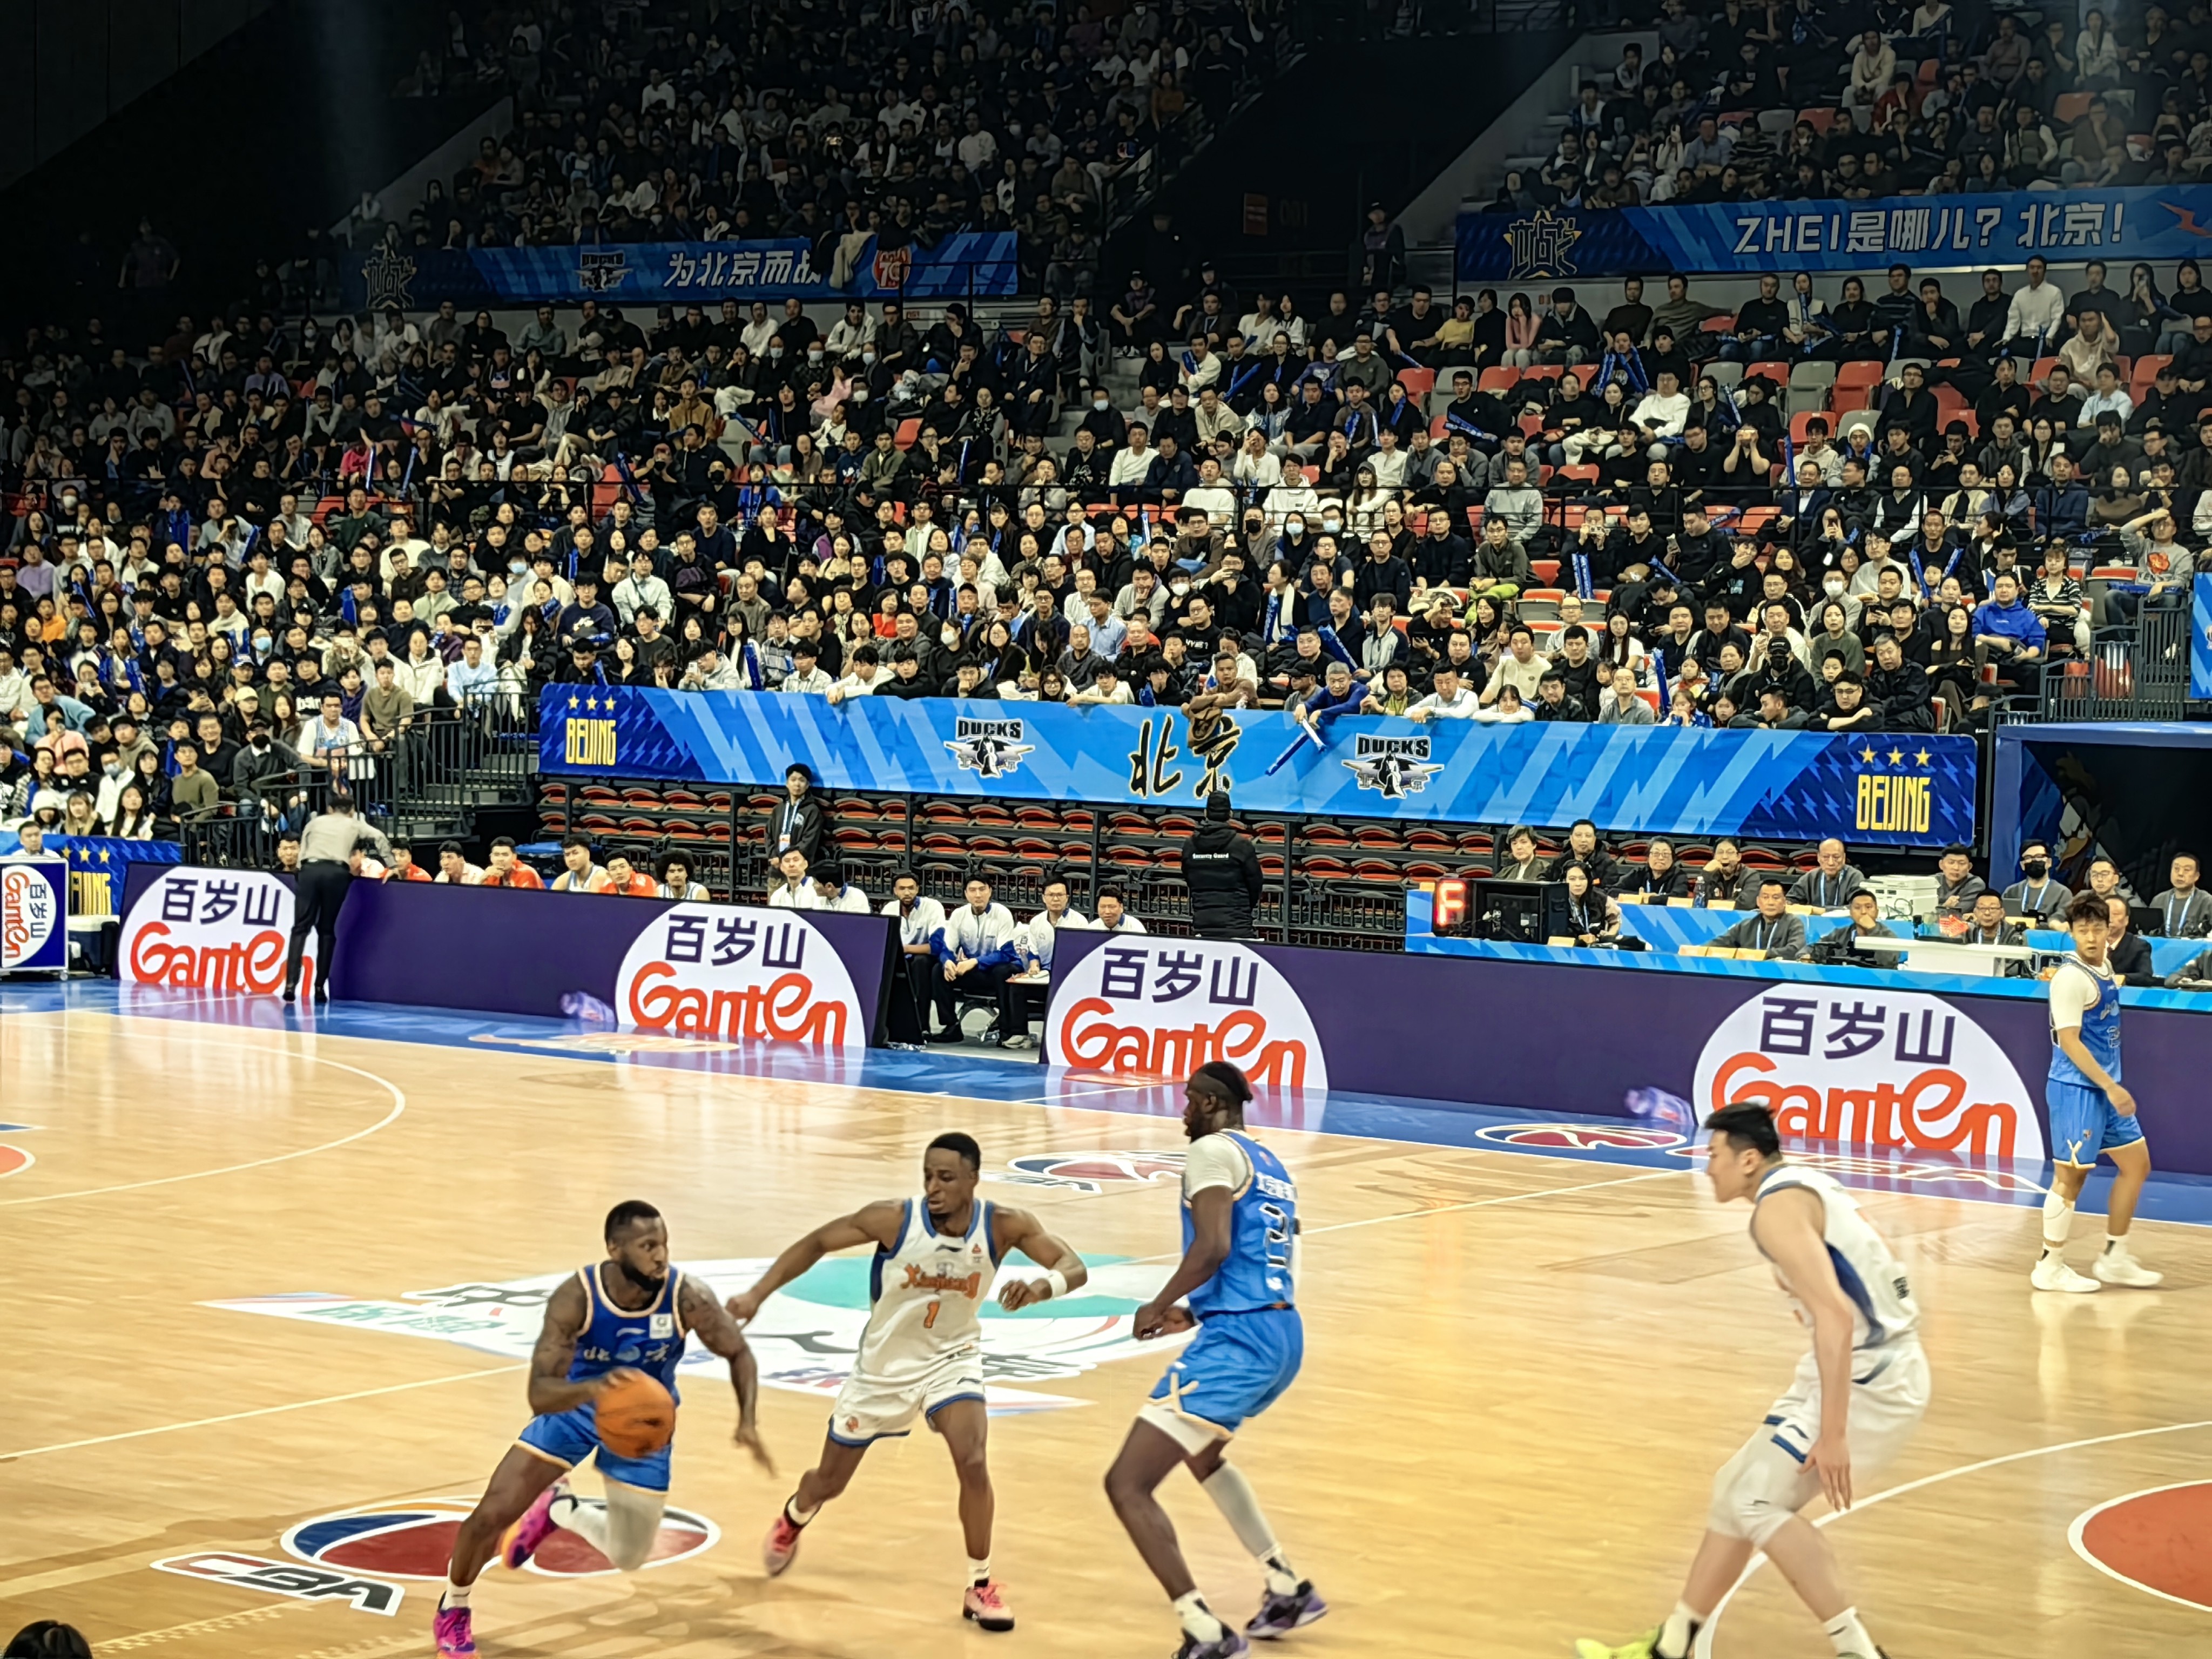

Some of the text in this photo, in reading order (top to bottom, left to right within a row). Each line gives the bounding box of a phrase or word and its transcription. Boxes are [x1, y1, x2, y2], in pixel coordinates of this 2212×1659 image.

[565, 718, 616, 766] BEIJING
[958, 720, 1022, 739] DUCKS
[1128, 713, 1242, 800] 北京
[1358, 736, 1429, 758] DUCKS
[1856, 774, 1931, 833] BEIJING
[161, 877, 281, 927] 百岁山
[665, 914, 807, 970] 百岁山
[629, 961, 847, 1046] Ganten
[1101, 947, 1259, 1007] 百岁山
[1061, 997, 1306, 1088] Ganten
[1759, 996, 1956, 1065] 百岁山
